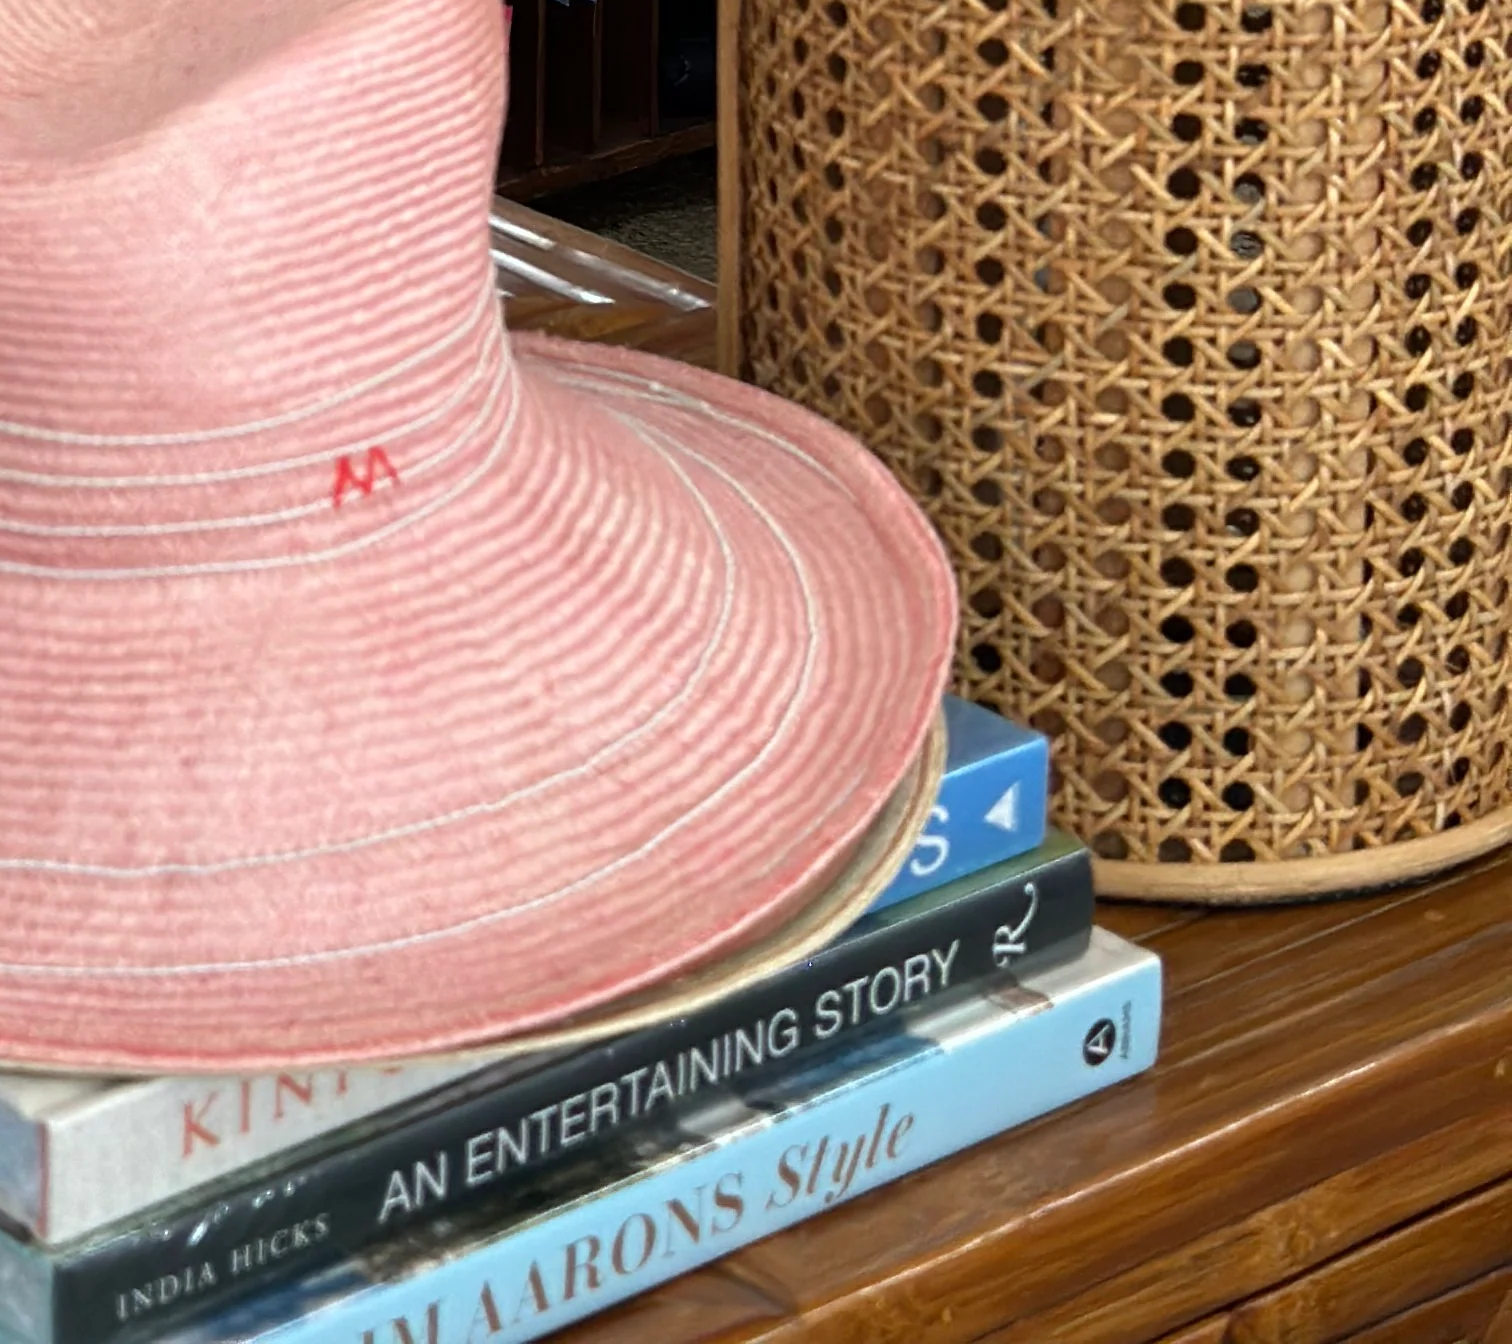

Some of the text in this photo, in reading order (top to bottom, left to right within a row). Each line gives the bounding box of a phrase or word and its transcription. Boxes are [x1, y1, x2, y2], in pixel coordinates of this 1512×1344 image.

[115, 939, 962, 1320] INDIA HICKS AN ENTERTAINING STORY
[182, 1070, 406, 1159] KIN
[466, 1170, 746, 1338] AARONS
[764, 1102, 916, 1211] Style
